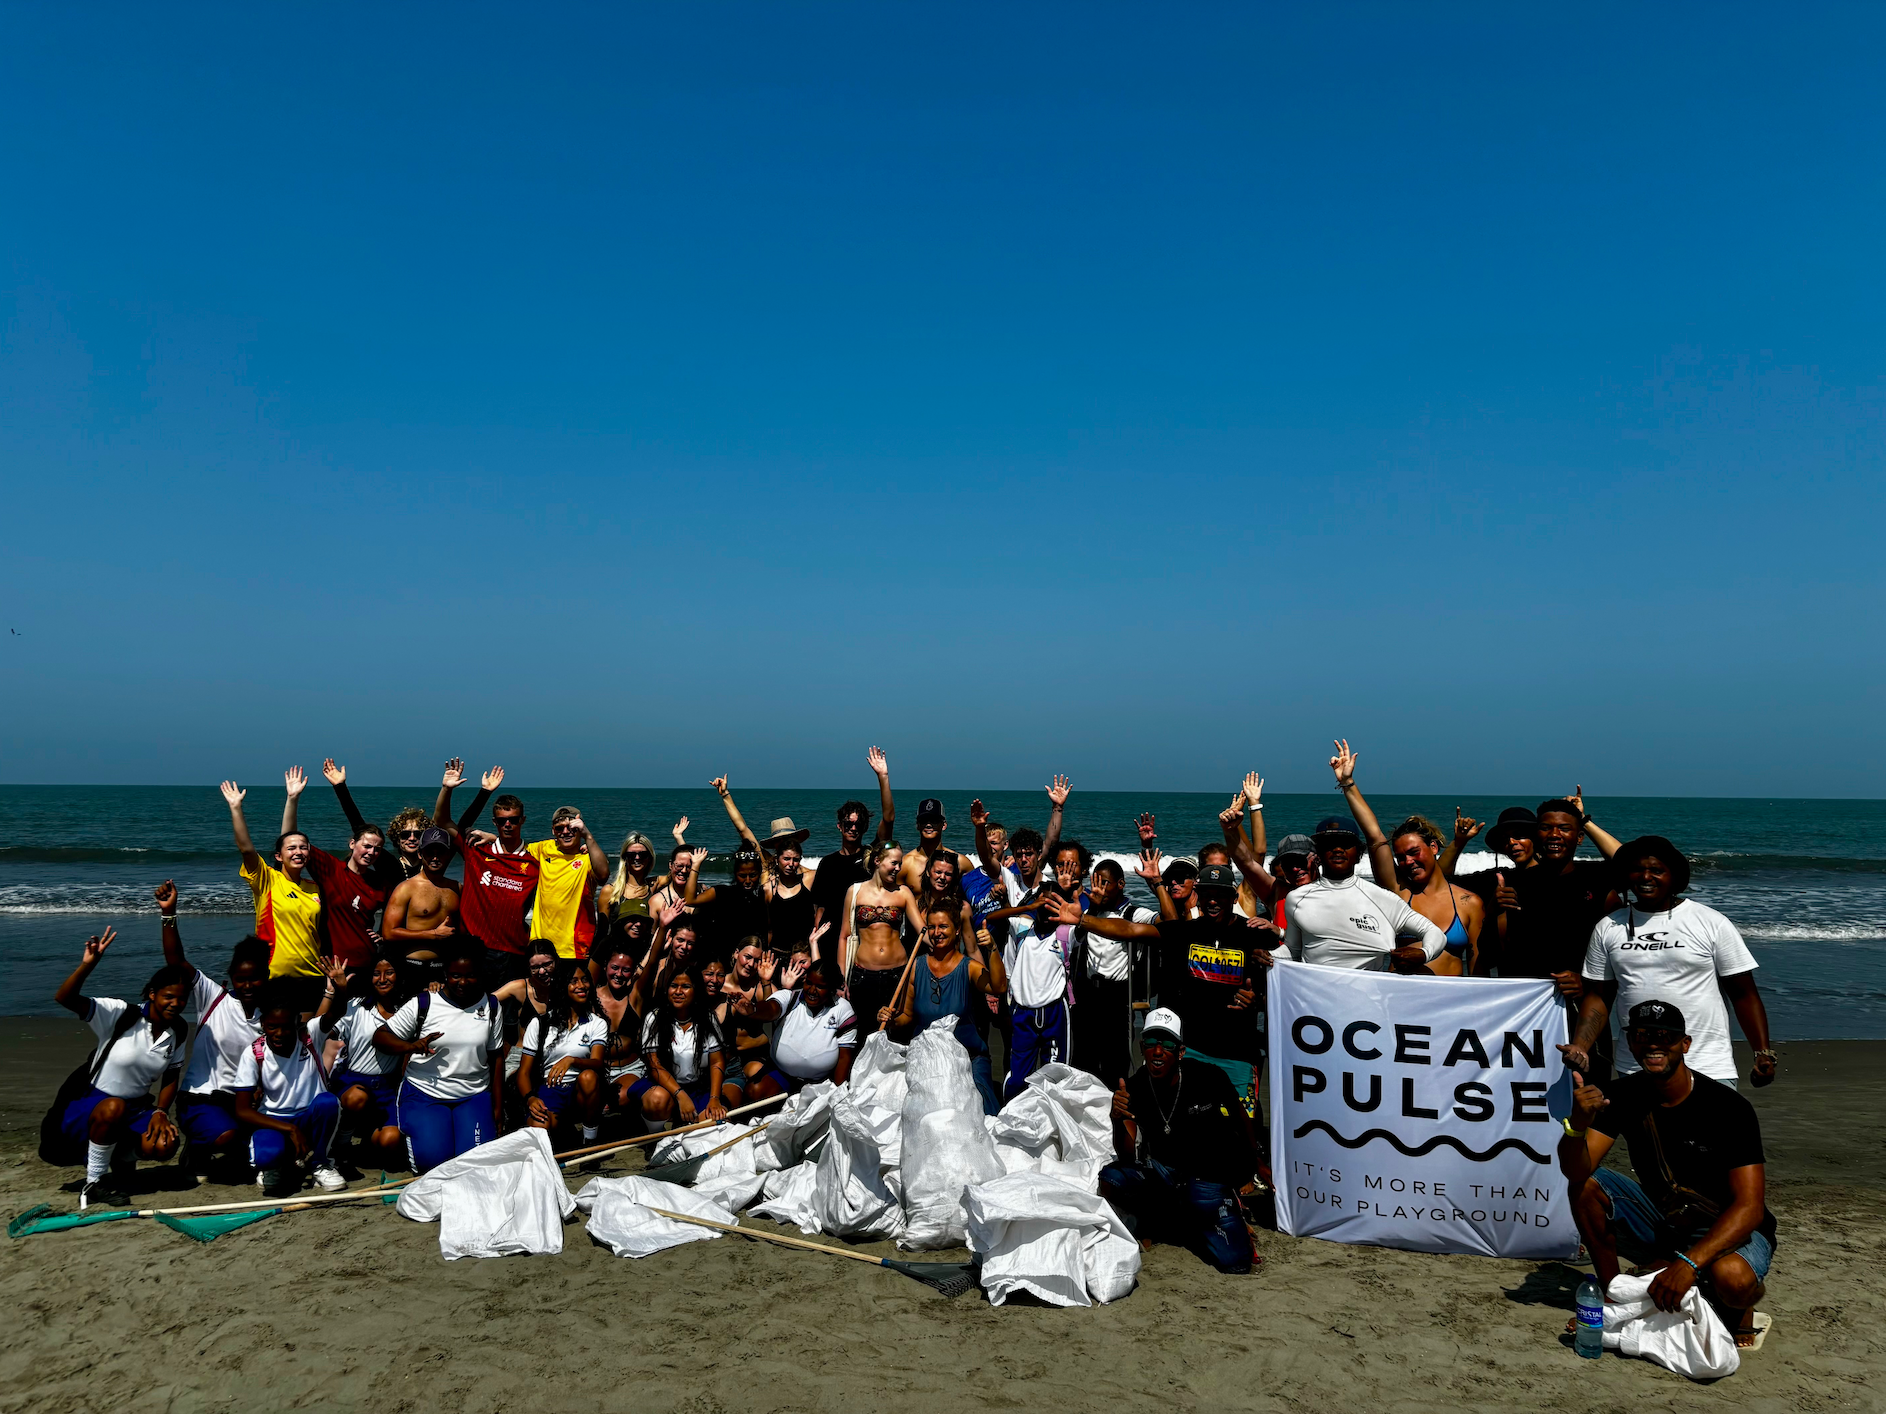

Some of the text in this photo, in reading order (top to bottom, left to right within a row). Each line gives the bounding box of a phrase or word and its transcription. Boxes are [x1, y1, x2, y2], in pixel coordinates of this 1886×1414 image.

[492, 880, 523, 892] chartered
[493, 875, 523, 887] standard
[1620, 940, 1686, 951] O'NEILL
[1291, 1015, 1546, 1069] OCEAN
[1292, 1064, 1550, 1123] PULSE
[1294, 1160, 1550, 1202] IT'S MORE THAN
[1296, 1186, 1550, 1228] OUR PLAYGROUND
